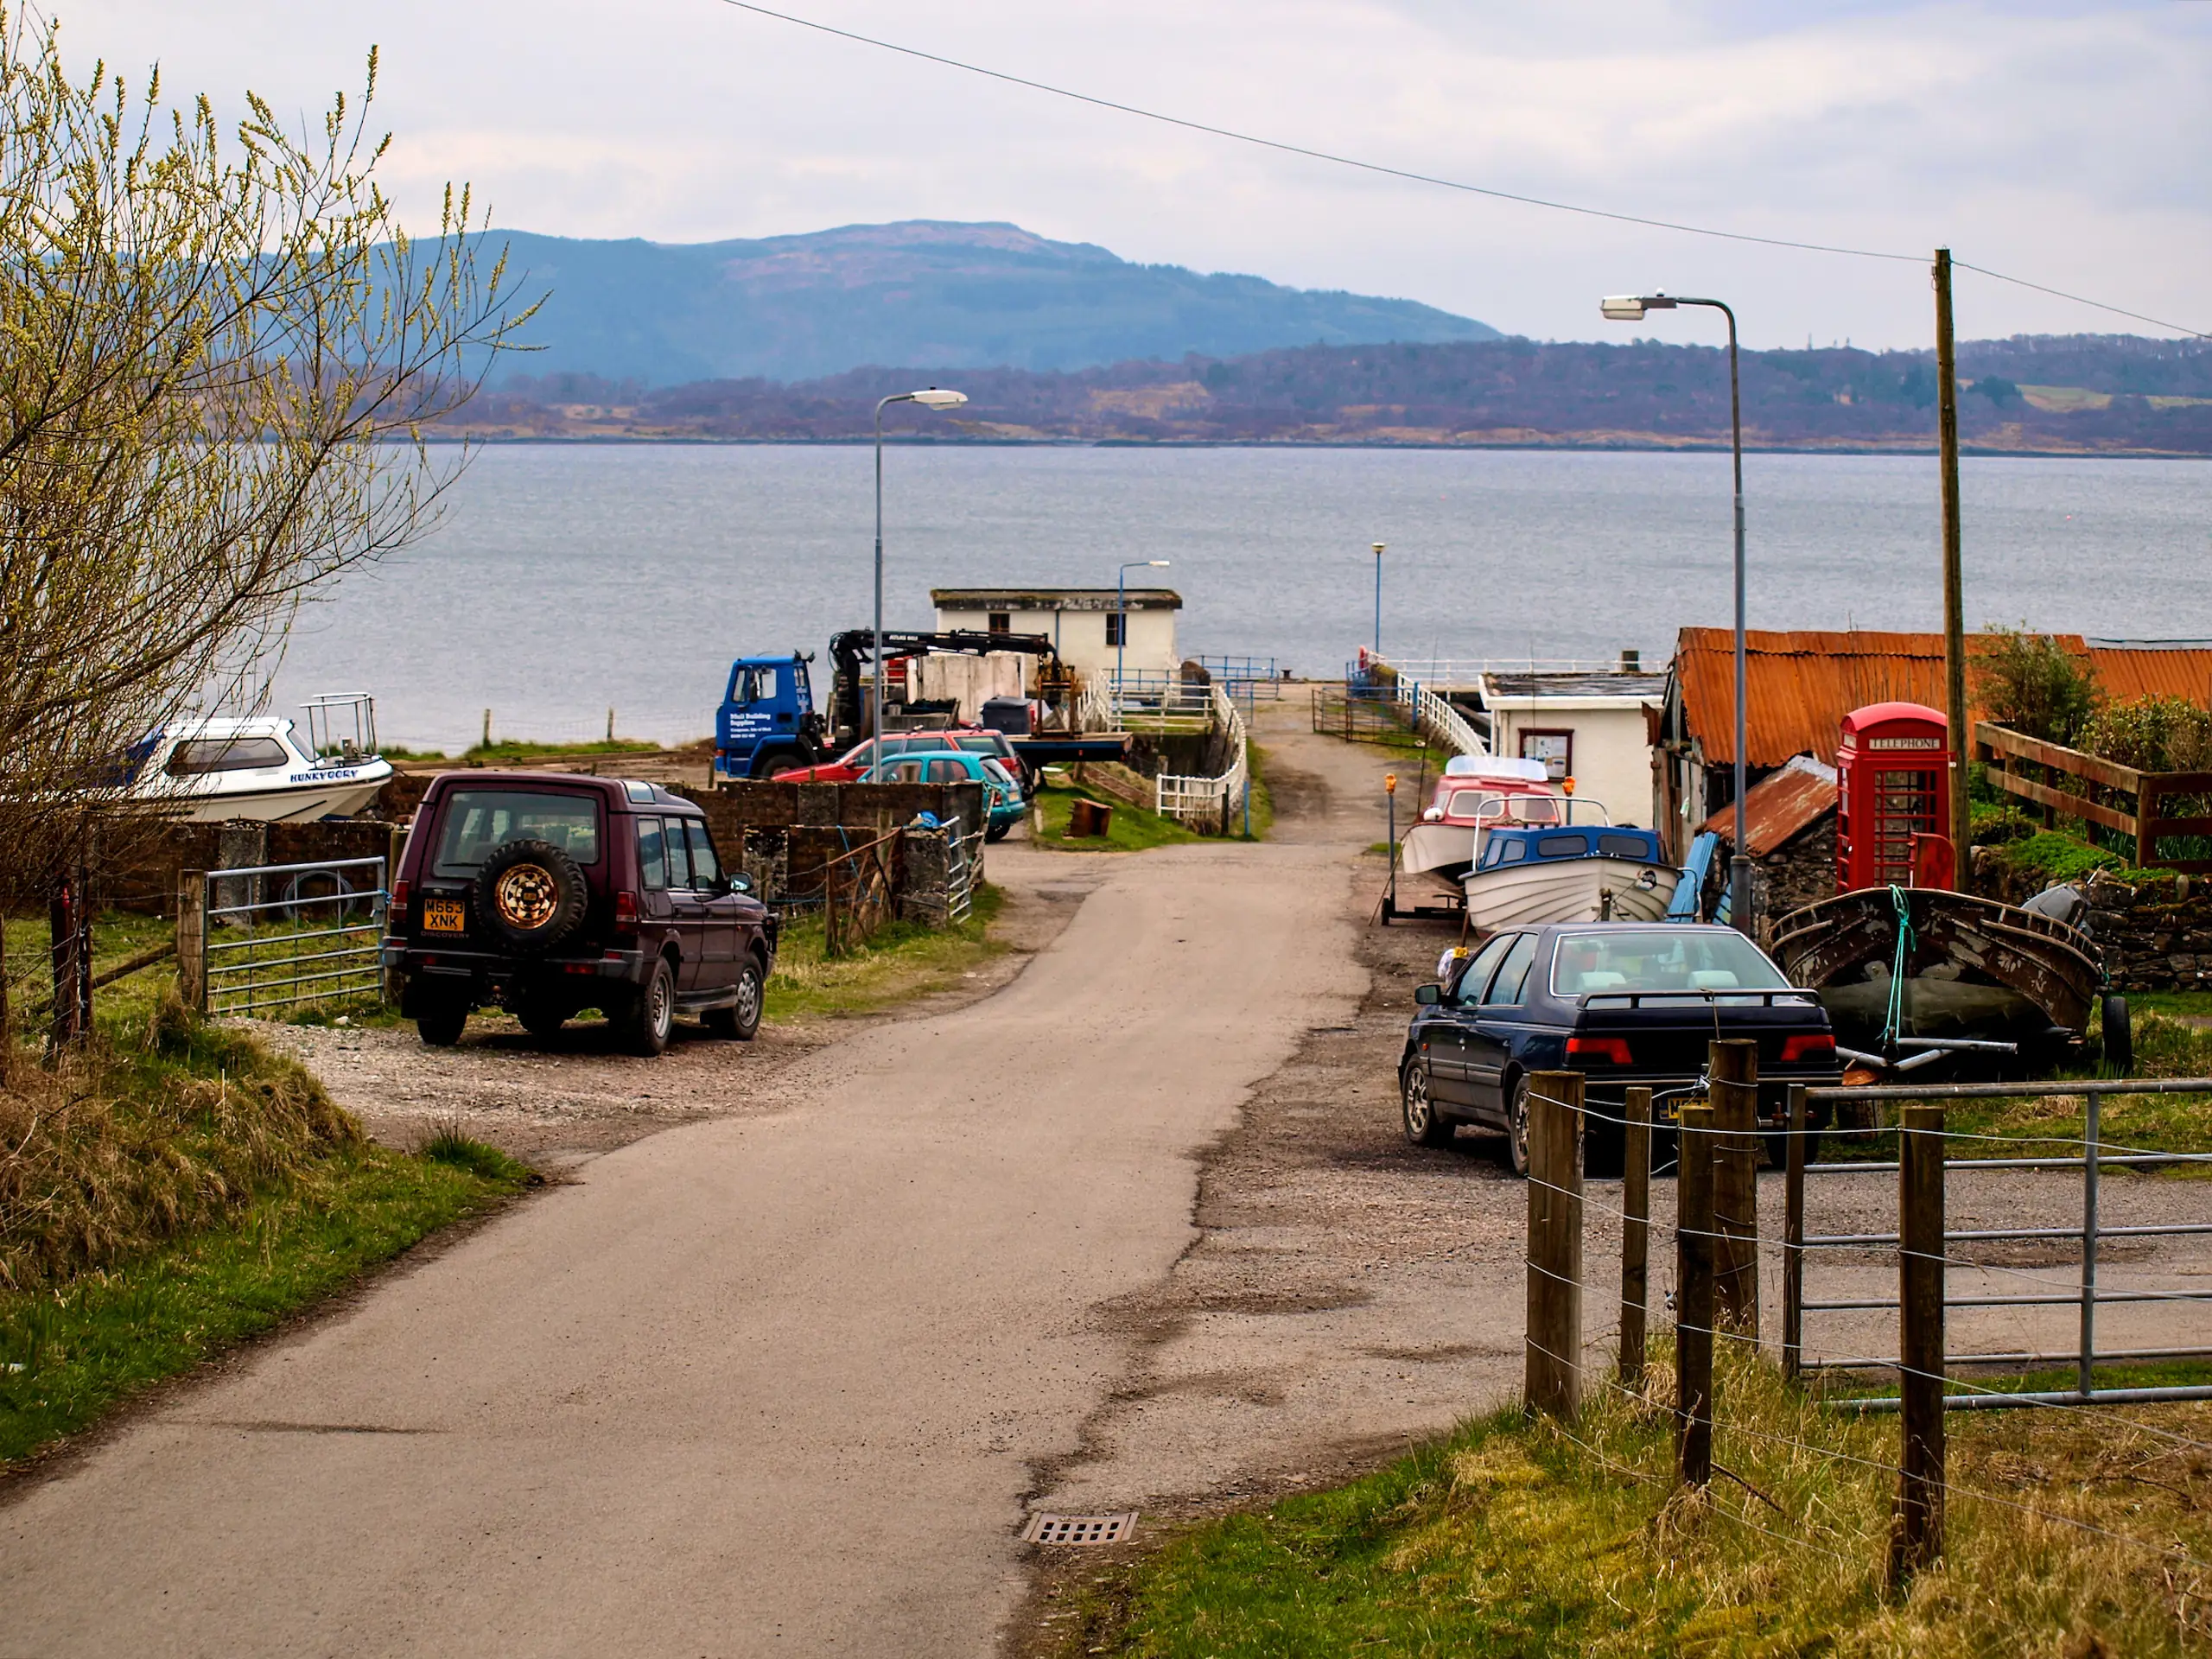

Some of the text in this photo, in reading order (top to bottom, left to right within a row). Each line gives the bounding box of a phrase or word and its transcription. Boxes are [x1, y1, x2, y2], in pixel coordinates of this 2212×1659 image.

[1873, 739, 1938, 748] TELEPHONE
[426, 899, 464, 913] M663
[430, 914, 457, 926] XNK
